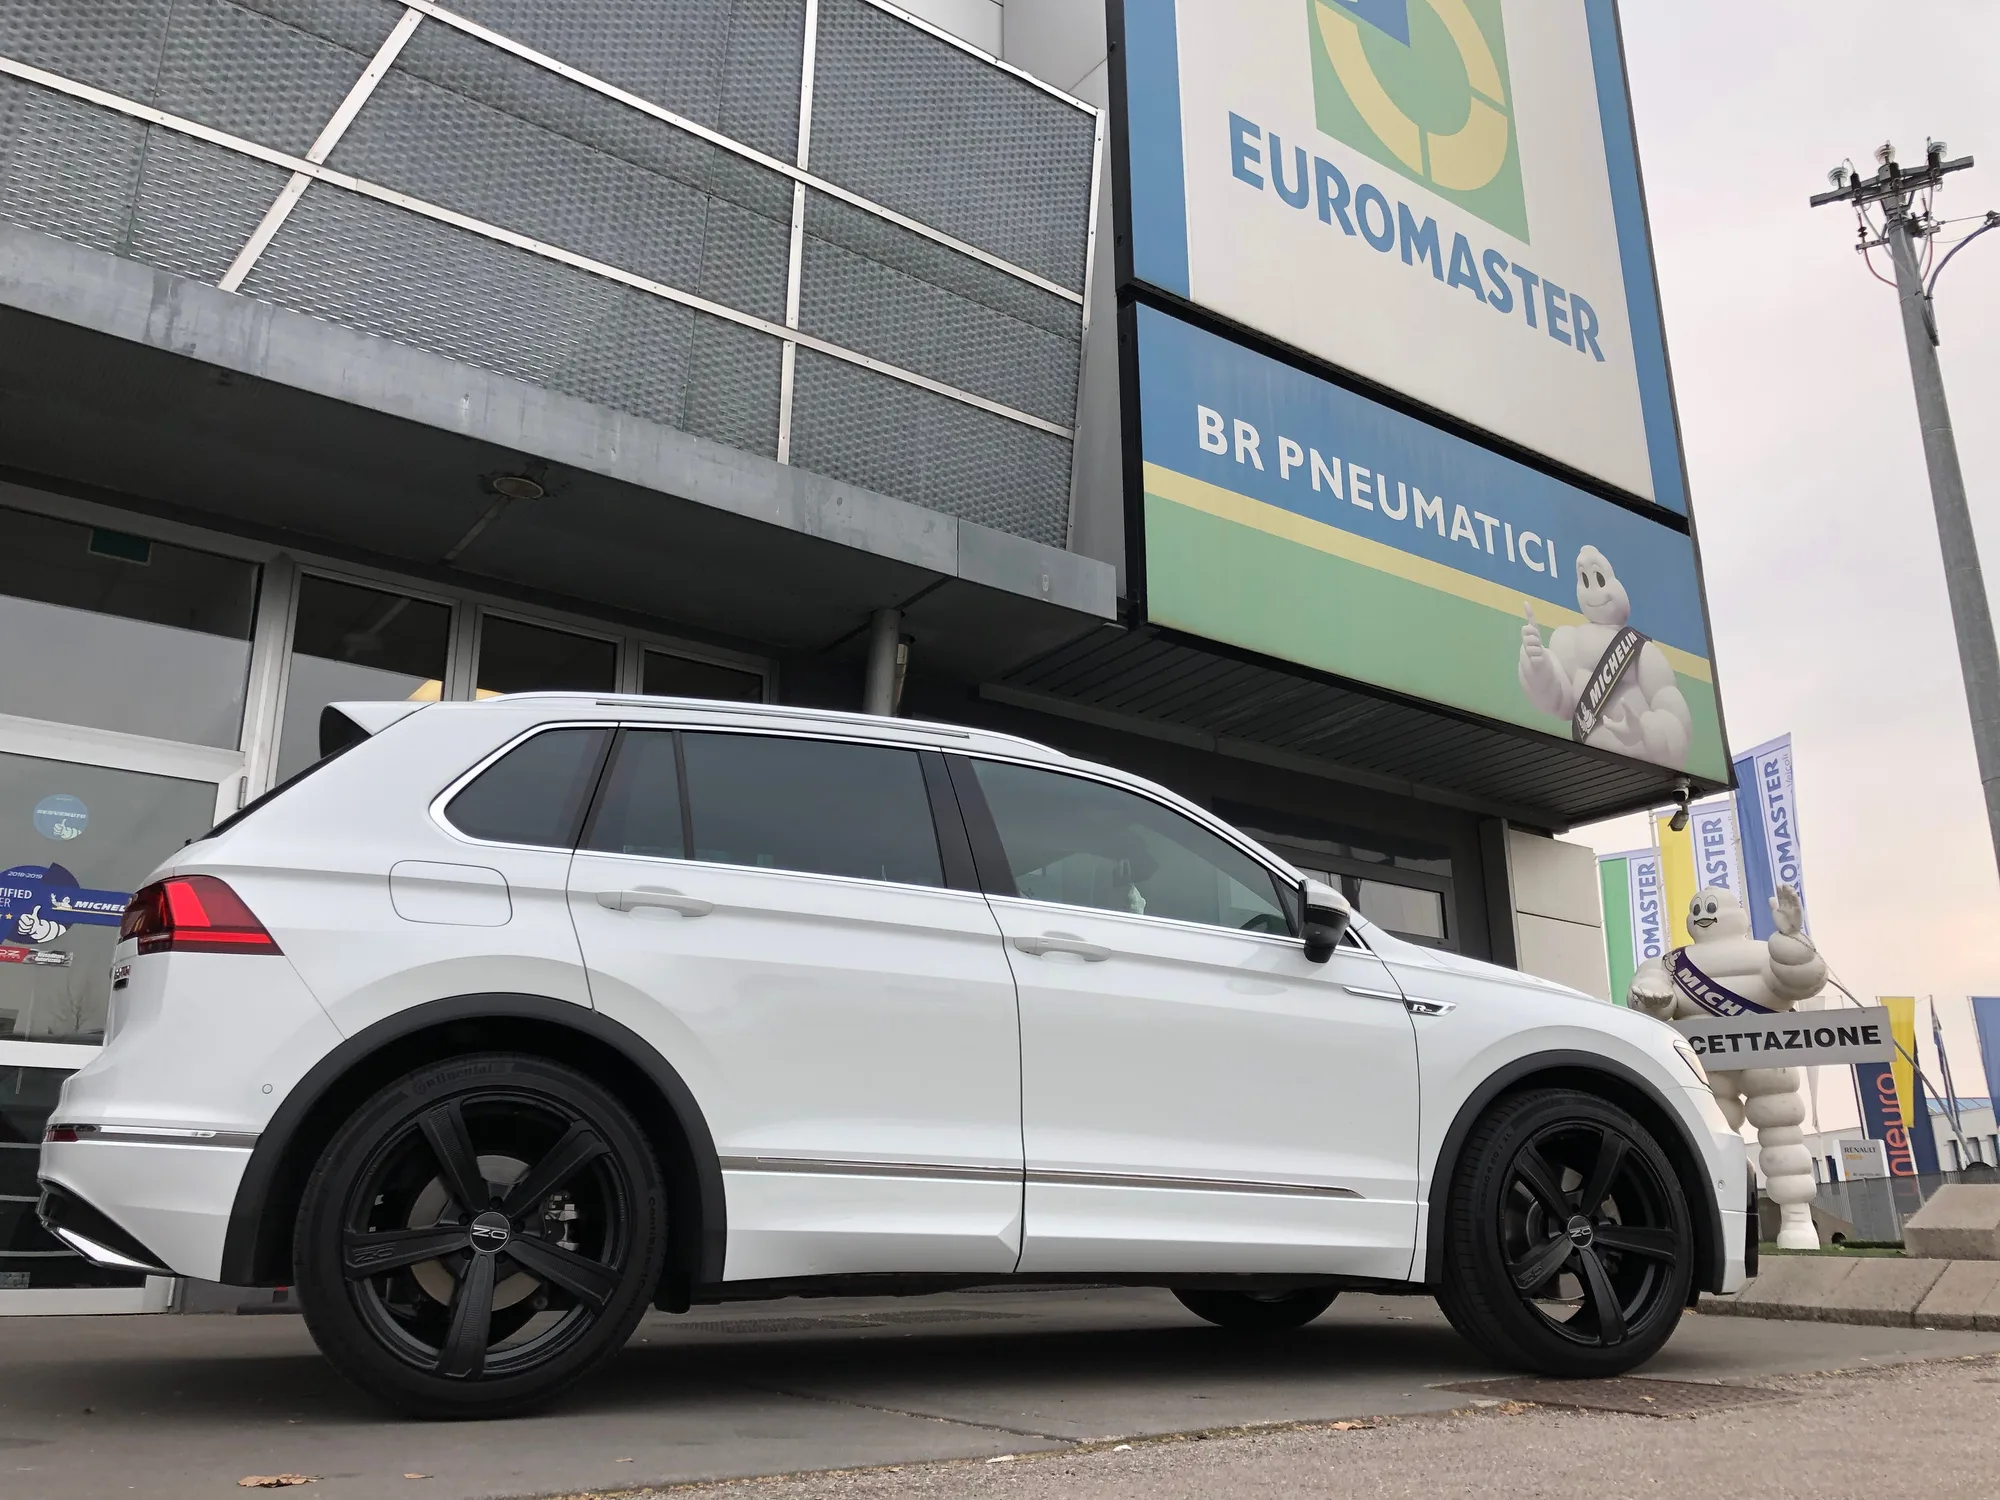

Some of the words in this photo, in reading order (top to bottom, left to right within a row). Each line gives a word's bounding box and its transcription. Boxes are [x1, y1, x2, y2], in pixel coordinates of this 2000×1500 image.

[1228, 110, 1605, 363] EUROMASTER
[1197, 404, 1265, 472] BR
[1278, 435, 1558, 579] PNEUMATICI
[1589, 631, 1638, 708] MICHELIN
[8, 871, 43, 879] 2018-2019
[1637, 861, 1662, 959] OMASTER
[1677, 967, 1757, 1017] MICH
[1688, 1025, 1882, 1055] CETTAZIONE
